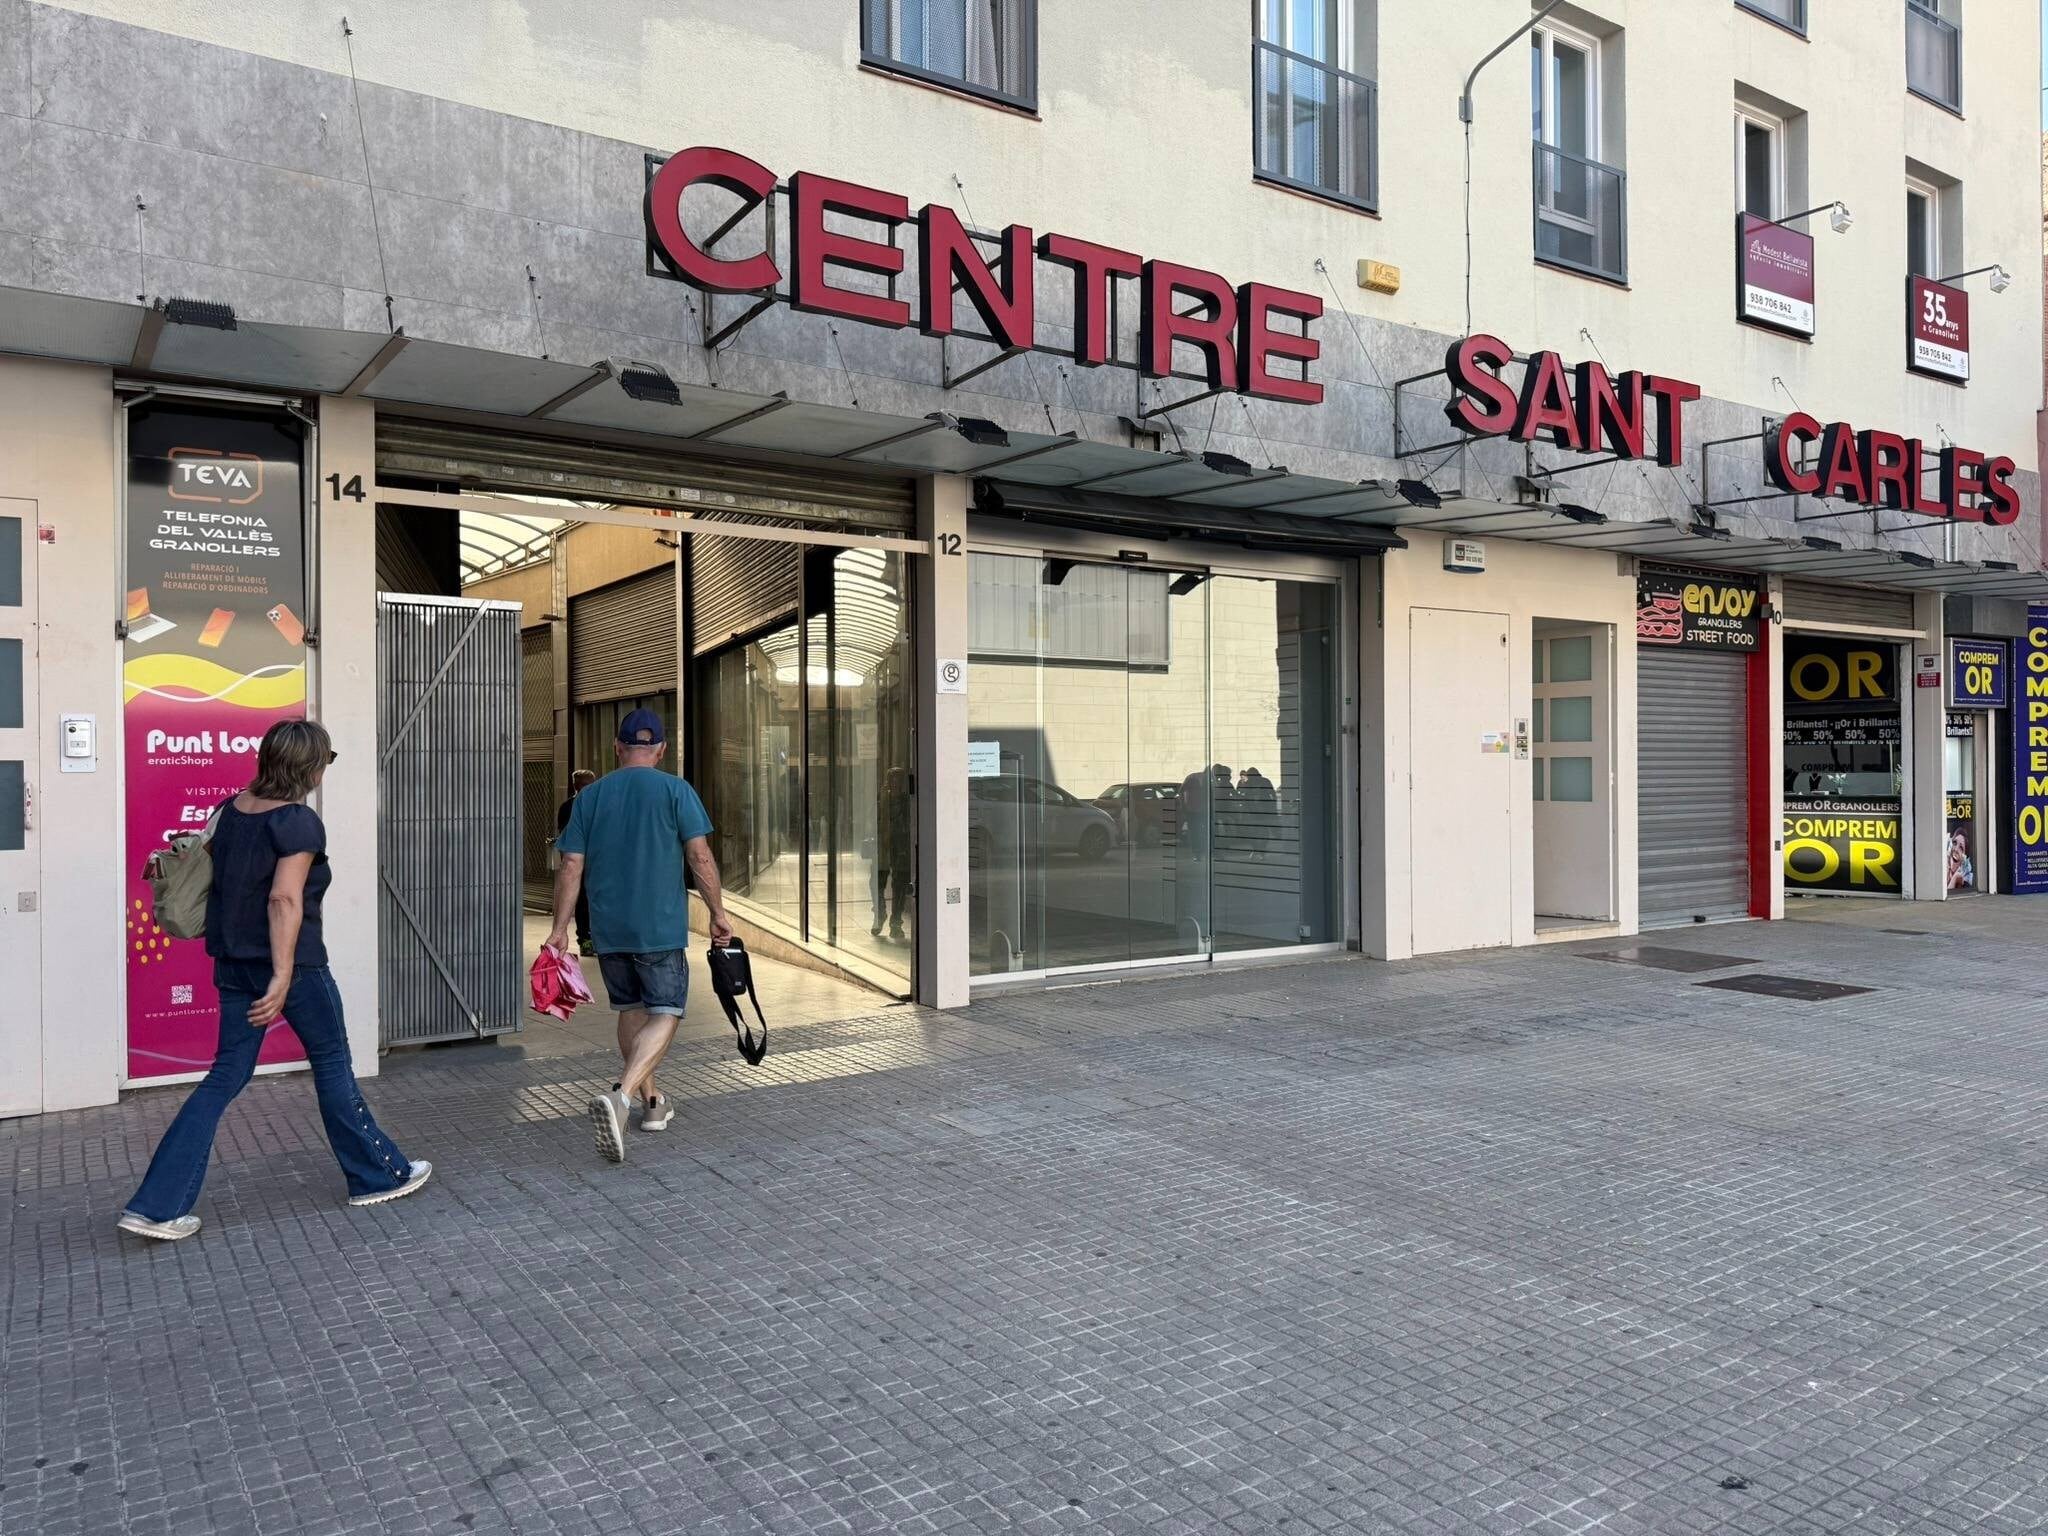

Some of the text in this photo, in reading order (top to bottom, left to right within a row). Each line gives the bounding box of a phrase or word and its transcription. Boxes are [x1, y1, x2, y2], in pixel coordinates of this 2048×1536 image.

[1750, 292, 1763, 305] 938
[1765, 297, 1778, 309] 706
[1780, 302, 1792, 313] 842
[1923, 289, 1959, 332] 35 anys
[643, 146, 2020, 525] CENTRE SANT CARLES
[1928, 324, 1959, 341] Granollers
[1918, 345, 1929, 356] 938
[1941, 352, 1952, 362] 842
[177, 463, 252, 488] TEVA
[325, 473, 366, 503] 14
[162, 510, 268, 527] TELEFONIA
[157, 524, 273, 542] DEL VALLÈS
[149, 538, 281, 557] GRANOLLERS
[937, 533, 962, 556] 12
[164, 571, 223, 582] ALLIBERAMENT
[225, 574, 235, 582] DE
[190, 563, 235, 573] REPARACIÓ
[163, 580, 207, 592] REPARACIÓ
[1697, 617, 1743, 629] GRANOLLERS
[1686, 630, 1754, 645] STREET FOOD
[1958, 651, 1999, 665] COMPREM
[1790, 651, 1887, 700] OR
[1964, 665, 1993, 695] OR
[147, 729, 213, 753] Punt
[1813, 730, 1834, 741] 50%
[1845, 729, 1867, 740] 50%
[1878, 728, 1900, 740] 50%
[147, 755, 214, 767] eroticShops
[185, 787, 246, 796] VISITA'N
[1813, 800, 1831, 811] OR
[1832, 802, 1899, 812] GRANOLLERS
[1957, 805, 1971, 818] OR
[1783, 818, 1897, 839] COMPREM
[2018, 804, 2048, 846] O
[1783, 838, 1898, 887] OR
[145, 1007, 218, 1018] www.puntlove.es
